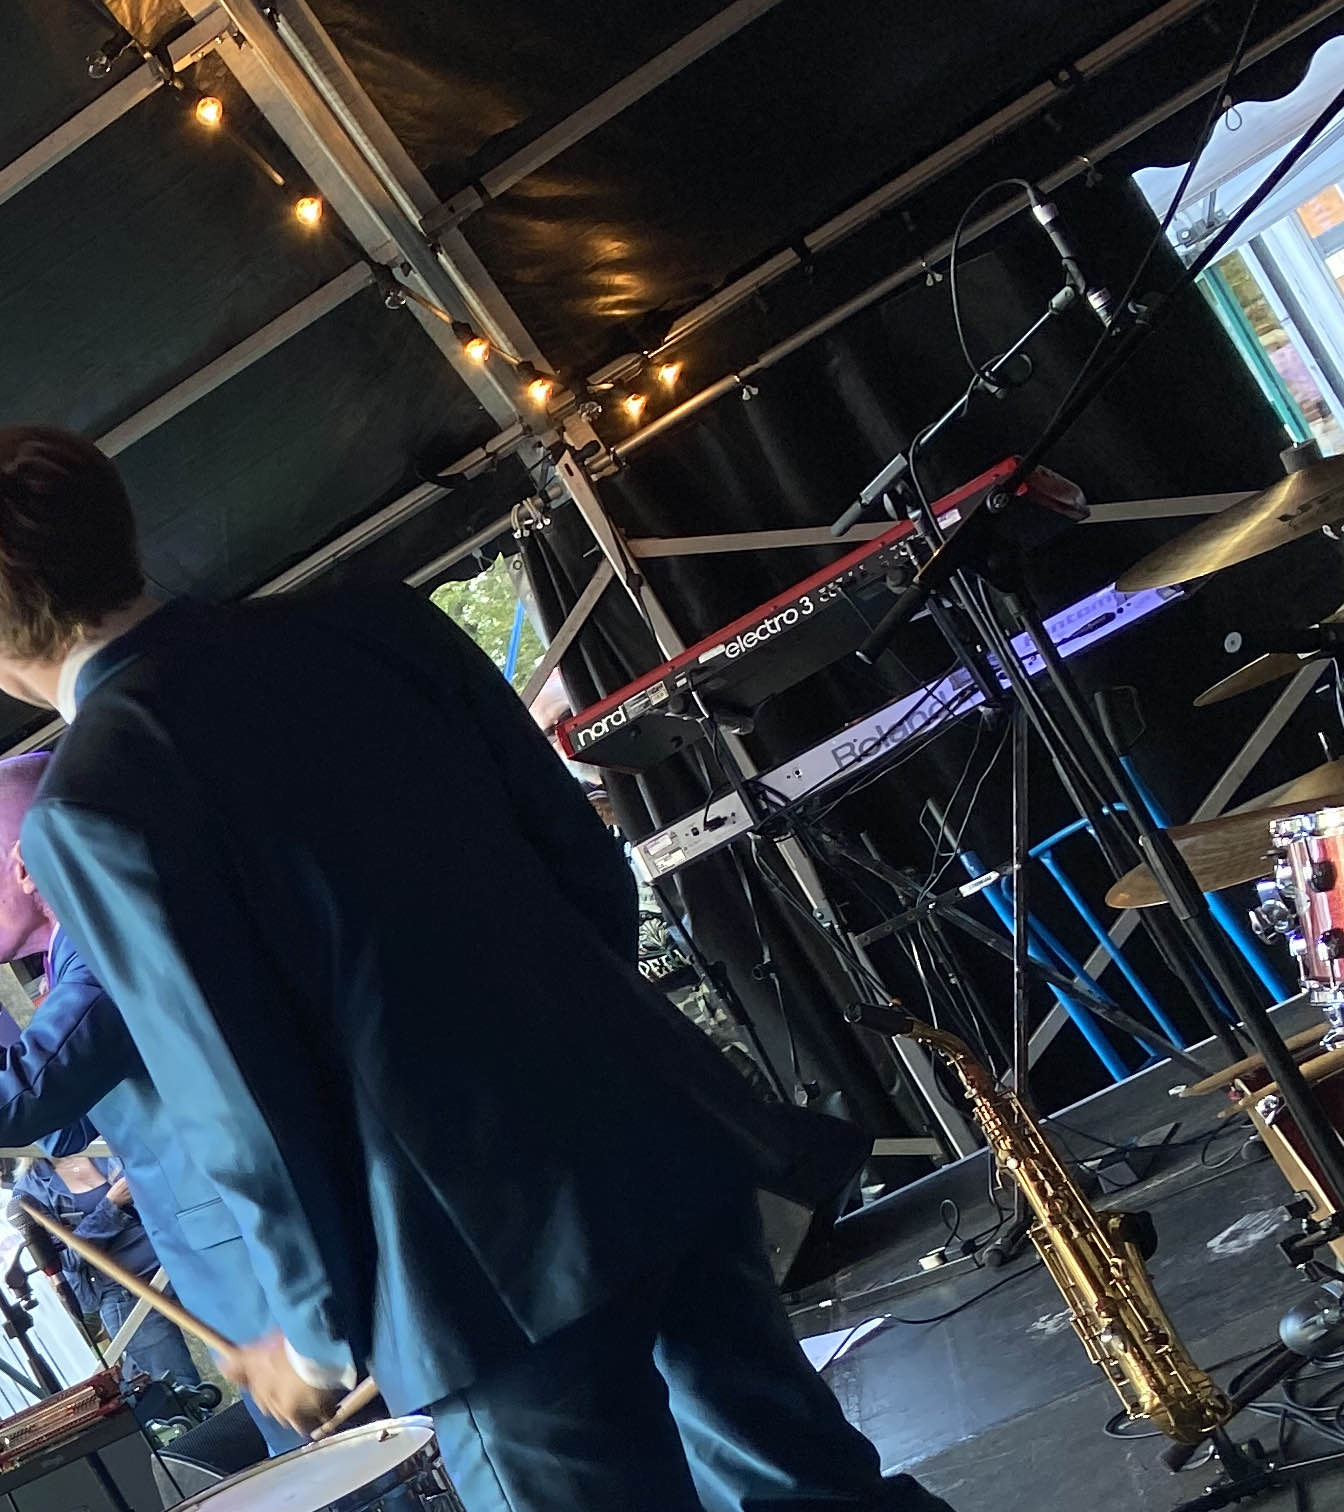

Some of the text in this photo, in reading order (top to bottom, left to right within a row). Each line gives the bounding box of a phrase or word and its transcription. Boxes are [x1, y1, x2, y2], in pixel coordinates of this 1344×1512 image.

[724, 596, 814, 659] electro 3
[577, 705, 628, 747] nord
[831, 690, 949, 770] Roland
